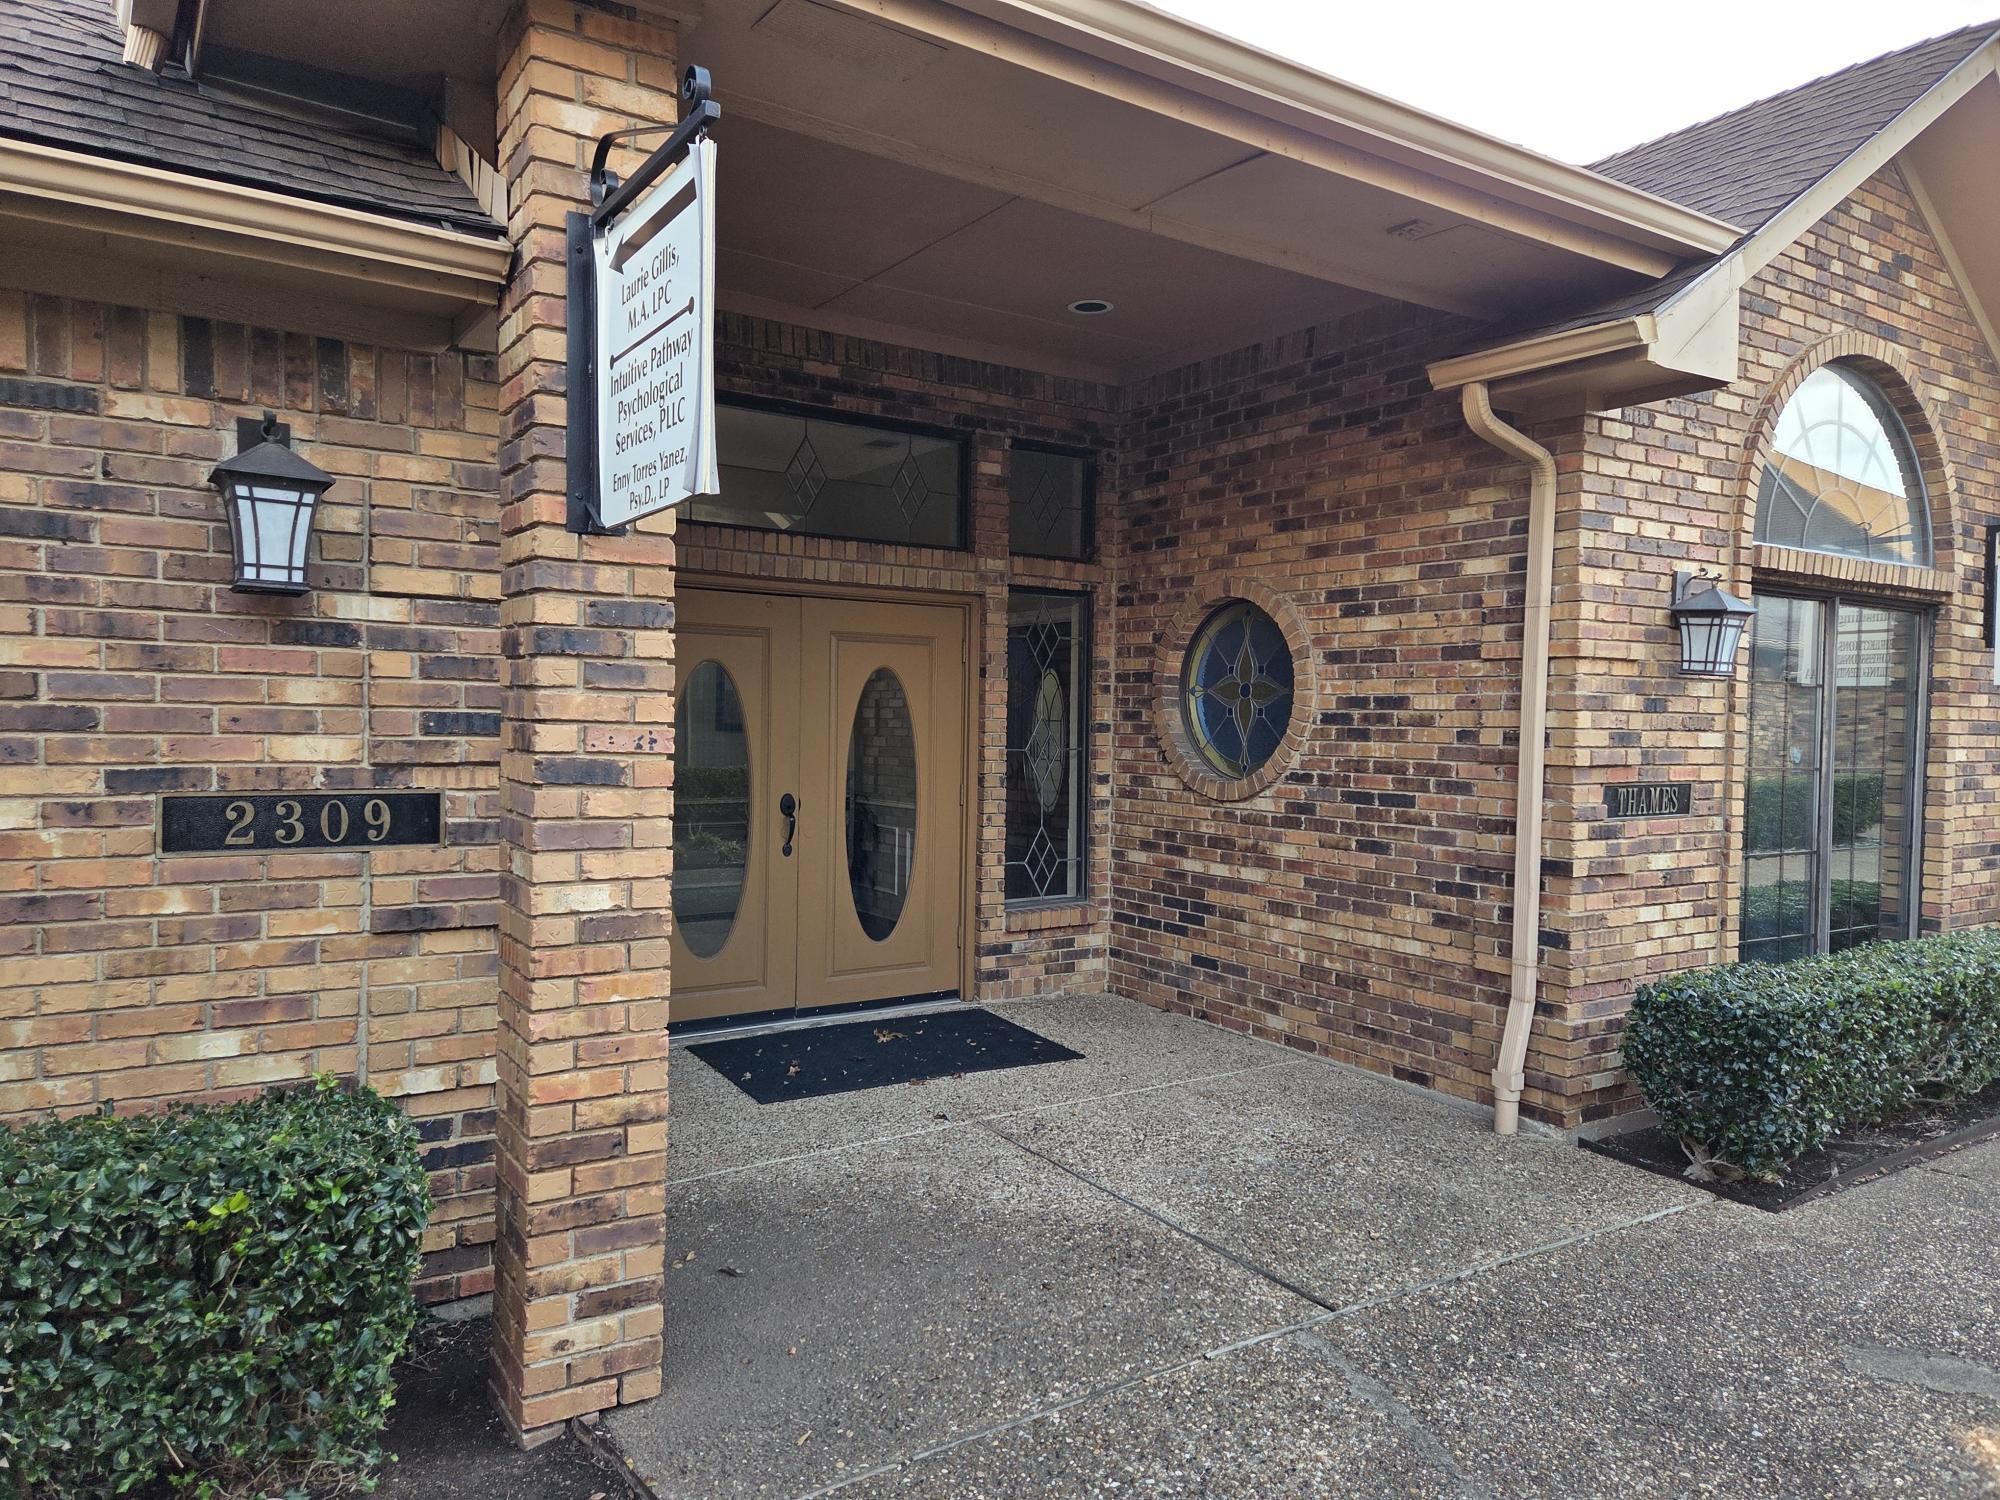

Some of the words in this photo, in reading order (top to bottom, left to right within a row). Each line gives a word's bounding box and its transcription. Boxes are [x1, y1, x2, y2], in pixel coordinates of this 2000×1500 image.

[621, 267, 649, 306] Laurie
[651, 243, 680, 280] Gillis,
[627, 300, 650, 334] M.A.
[652, 279, 672, 314] LPC
[610, 358, 648, 398] Intuitive
[650, 327, 694, 372] Pathway
[617, 361, 684, 426] Psychological
[615, 421, 657, 456] Services,
[659, 396, 686, 433] PLLC
[613, 470, 631, 493] Enny
[632, 459, 657, 484] Torres
[658, 446, 688, 472] Yanez,
[629, 484, 657, 513] Psy.D.,
[659, 476, 670, 500] LP
[224, 799, 391, 845] 2309
[1617, 786, 1679, 816] THAMES
